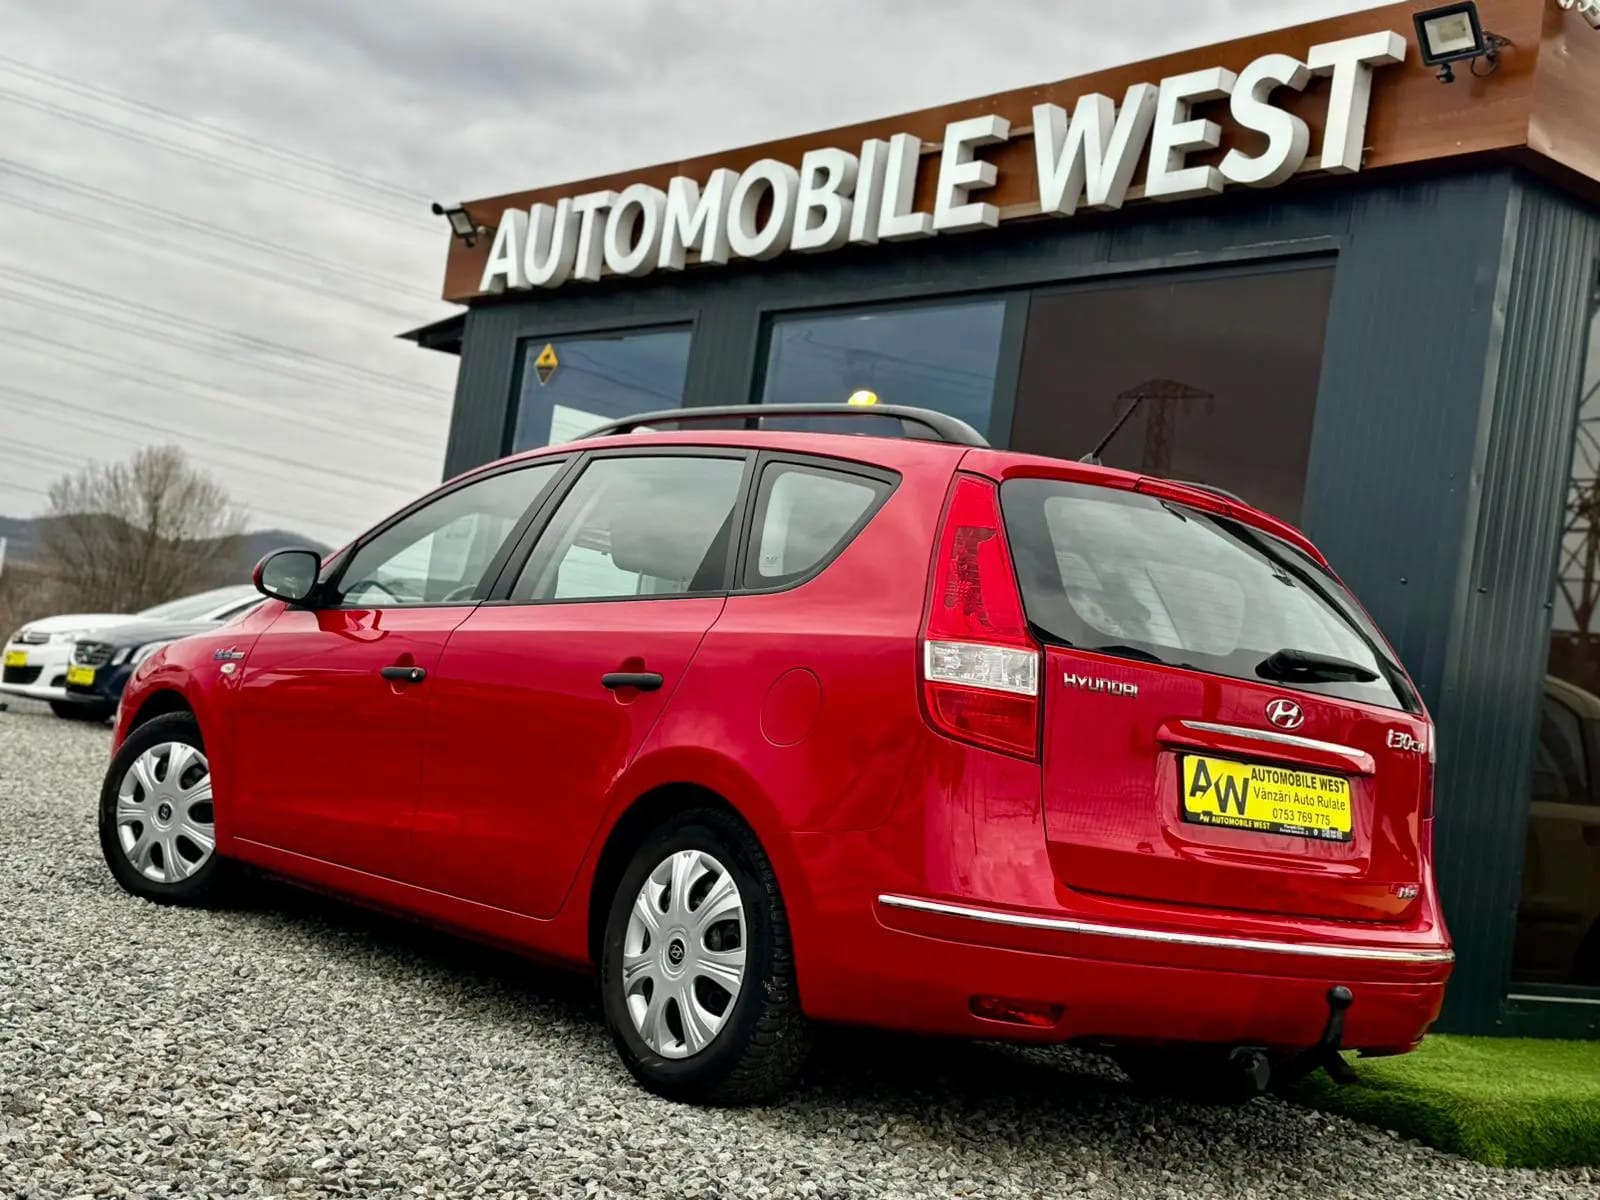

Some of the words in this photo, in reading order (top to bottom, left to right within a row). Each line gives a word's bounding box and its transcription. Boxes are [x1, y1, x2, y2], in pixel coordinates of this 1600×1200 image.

[479, 114, 1010, 293] AUTOMOBILE
[1032, 30, 1406, 218] WEST
[1063, 672, 1138, 697] HYUNDAI
[1251, 767, 1317, 790] AUTOMOBILE
[1319, 777, 1345, 794] WEST
[1293, 792, 1315, 807] Auto
[1317, 796, 1346, 811] Rulate
[1211, 815, 1252, 828] AUTOMOBILE
[1253, 820, 1271, 830] WEST
[1272, 807, 1296, 822] 0753
[1297, 811, 1313, 824] 769
[1315, 813, 1331, 826] 775
